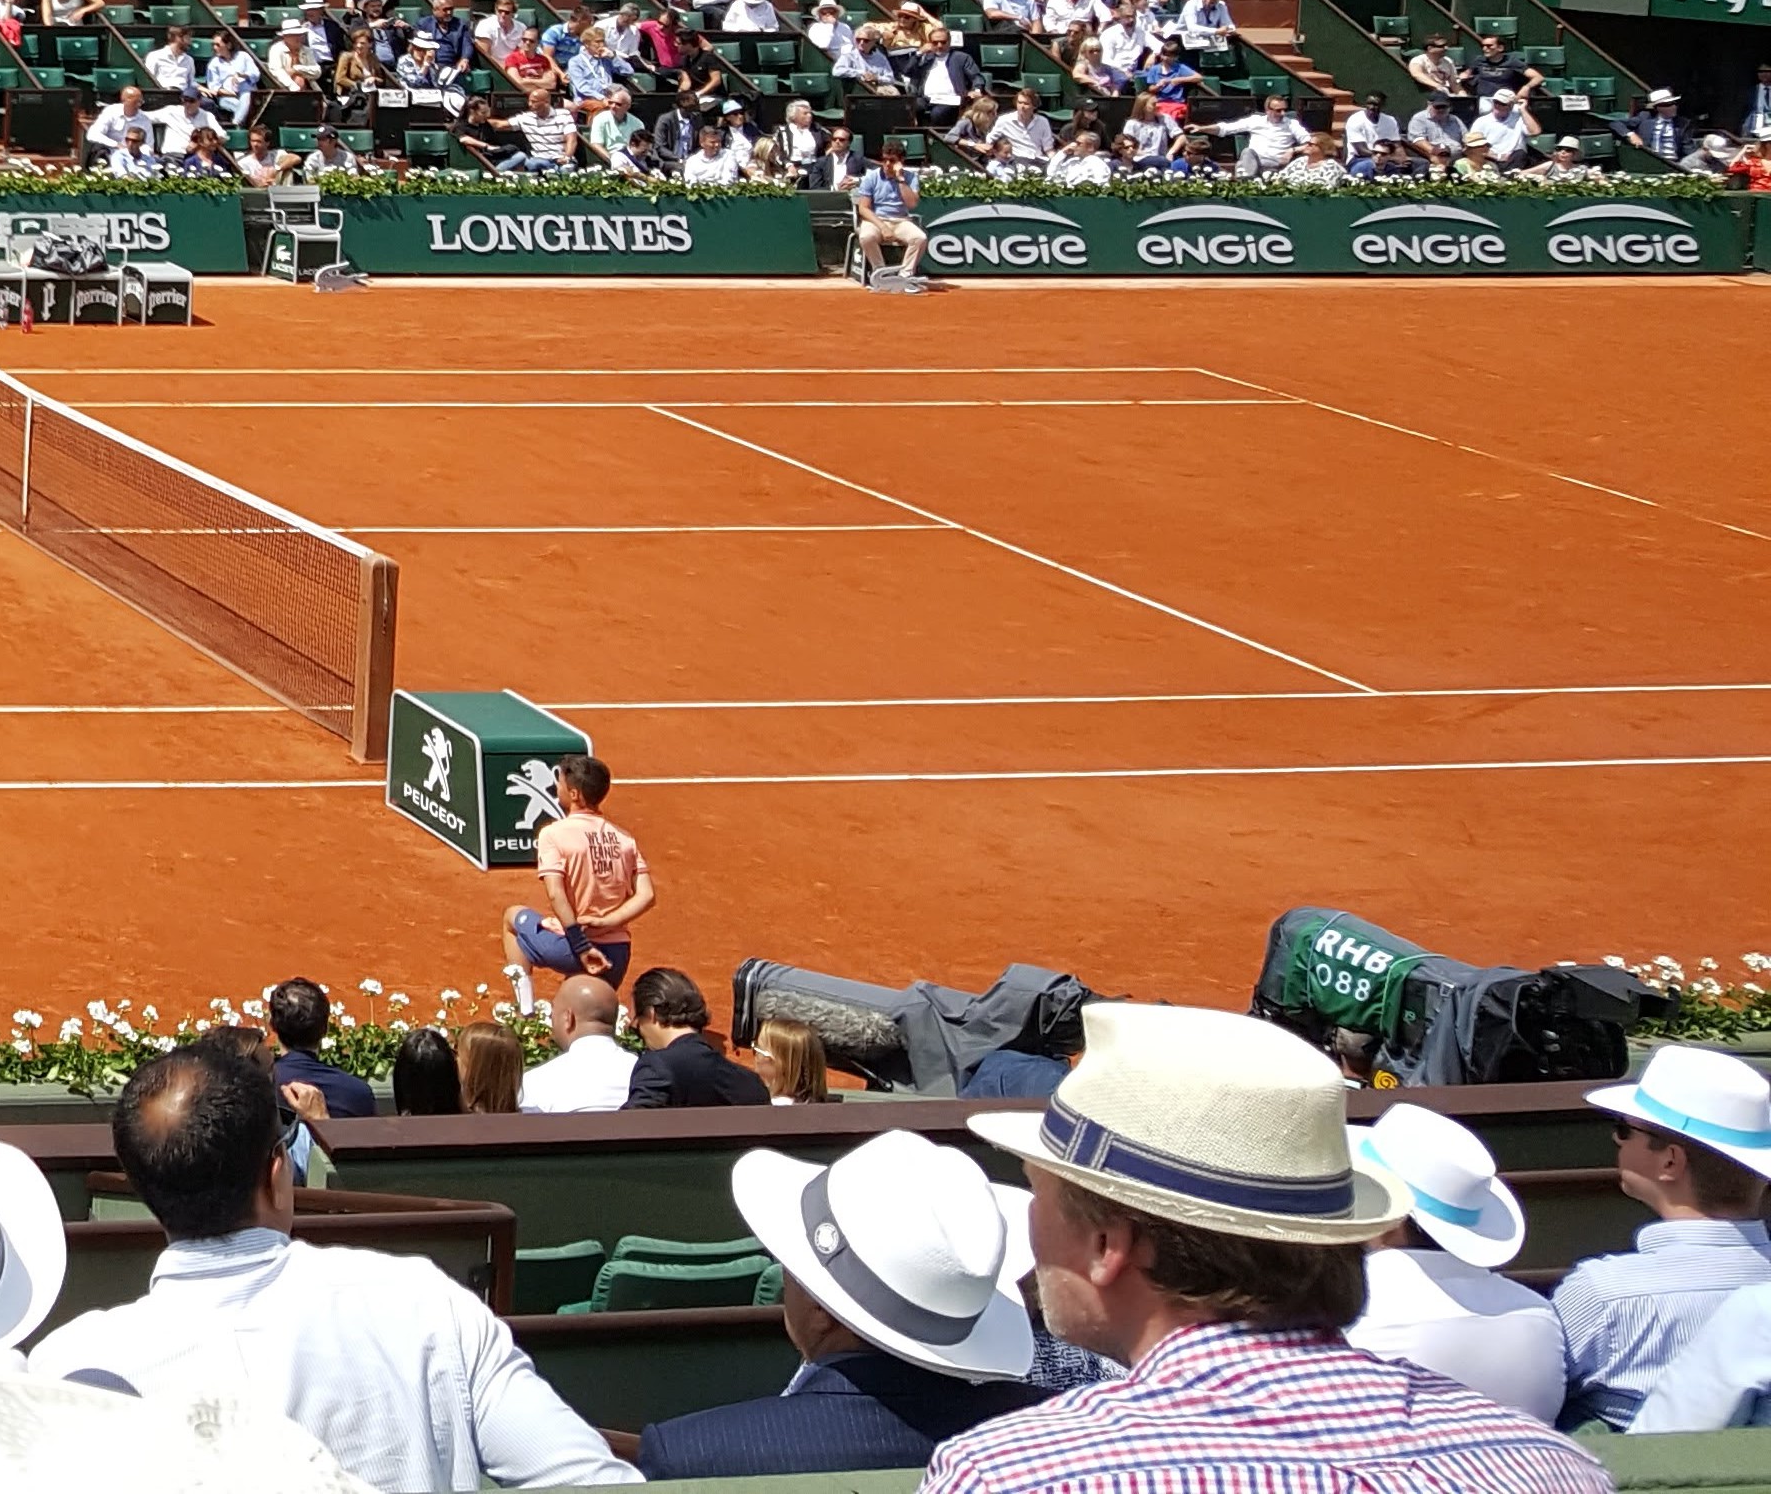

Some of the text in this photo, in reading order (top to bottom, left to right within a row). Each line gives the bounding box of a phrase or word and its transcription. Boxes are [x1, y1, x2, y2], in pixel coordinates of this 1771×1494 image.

[425, 213, 693, 253] LONGINES
[76, 285, 118, 317] perrier
[148, 286, 187, 317] perrier
[402, 782, 467, 835] PEUGEOT
[585, 831, 601, 845] WE
[1314, 929, 1394, 974] RHB
